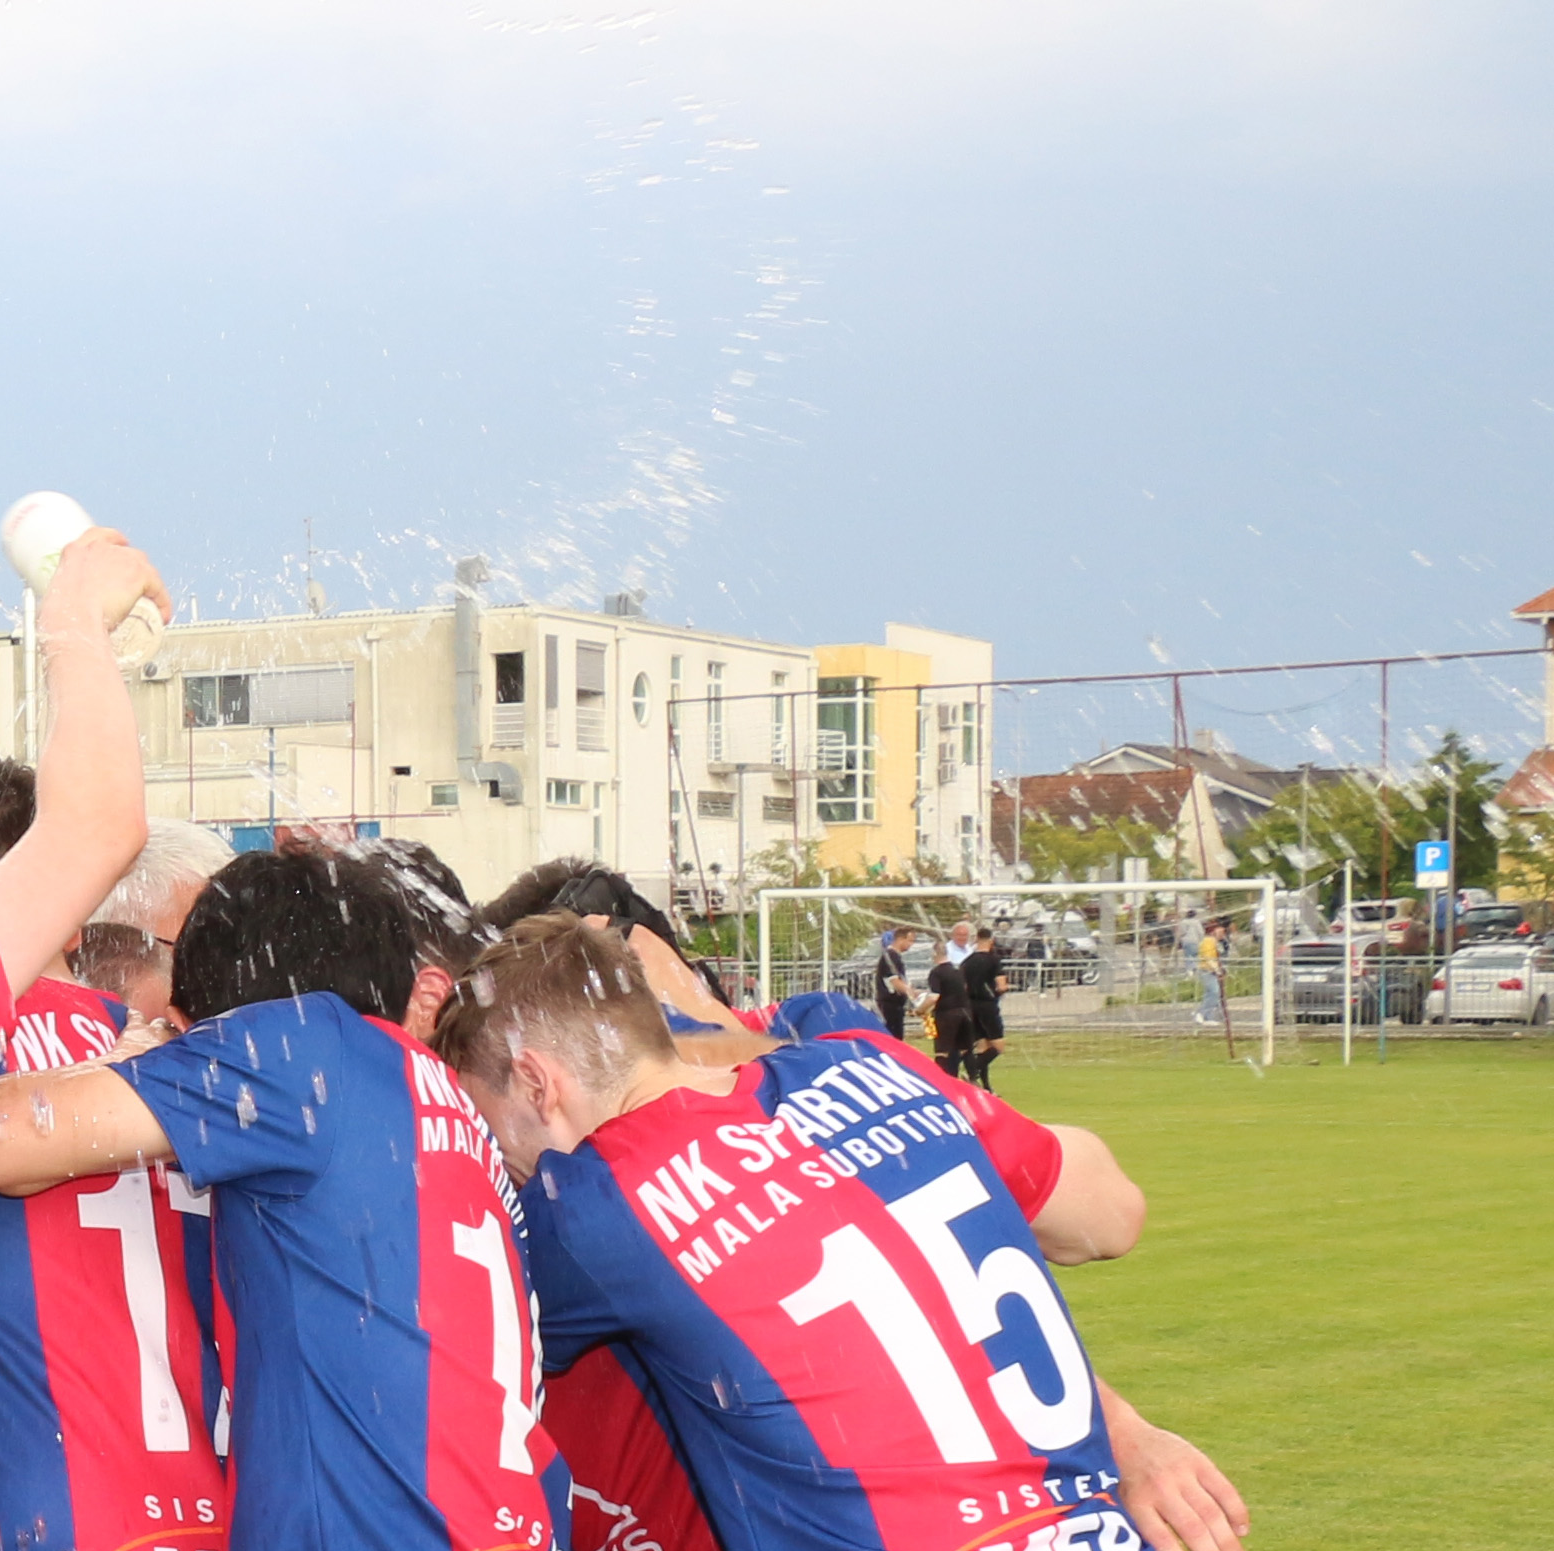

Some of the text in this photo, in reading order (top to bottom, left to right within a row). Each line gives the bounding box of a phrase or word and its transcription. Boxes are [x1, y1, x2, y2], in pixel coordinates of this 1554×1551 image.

[1425, 847, 1442, 867] P
[10, 1011, 75, 1072] NK
[636, 1139, 736, 1243] NK
[716, 1053, 938, 1173] SPARTAK
[677, 1103, 975, 1284] MALA SUBOTICA
[452, 1209, 545, 1475] 1
[778, 1162, 1093, 1464] 15
